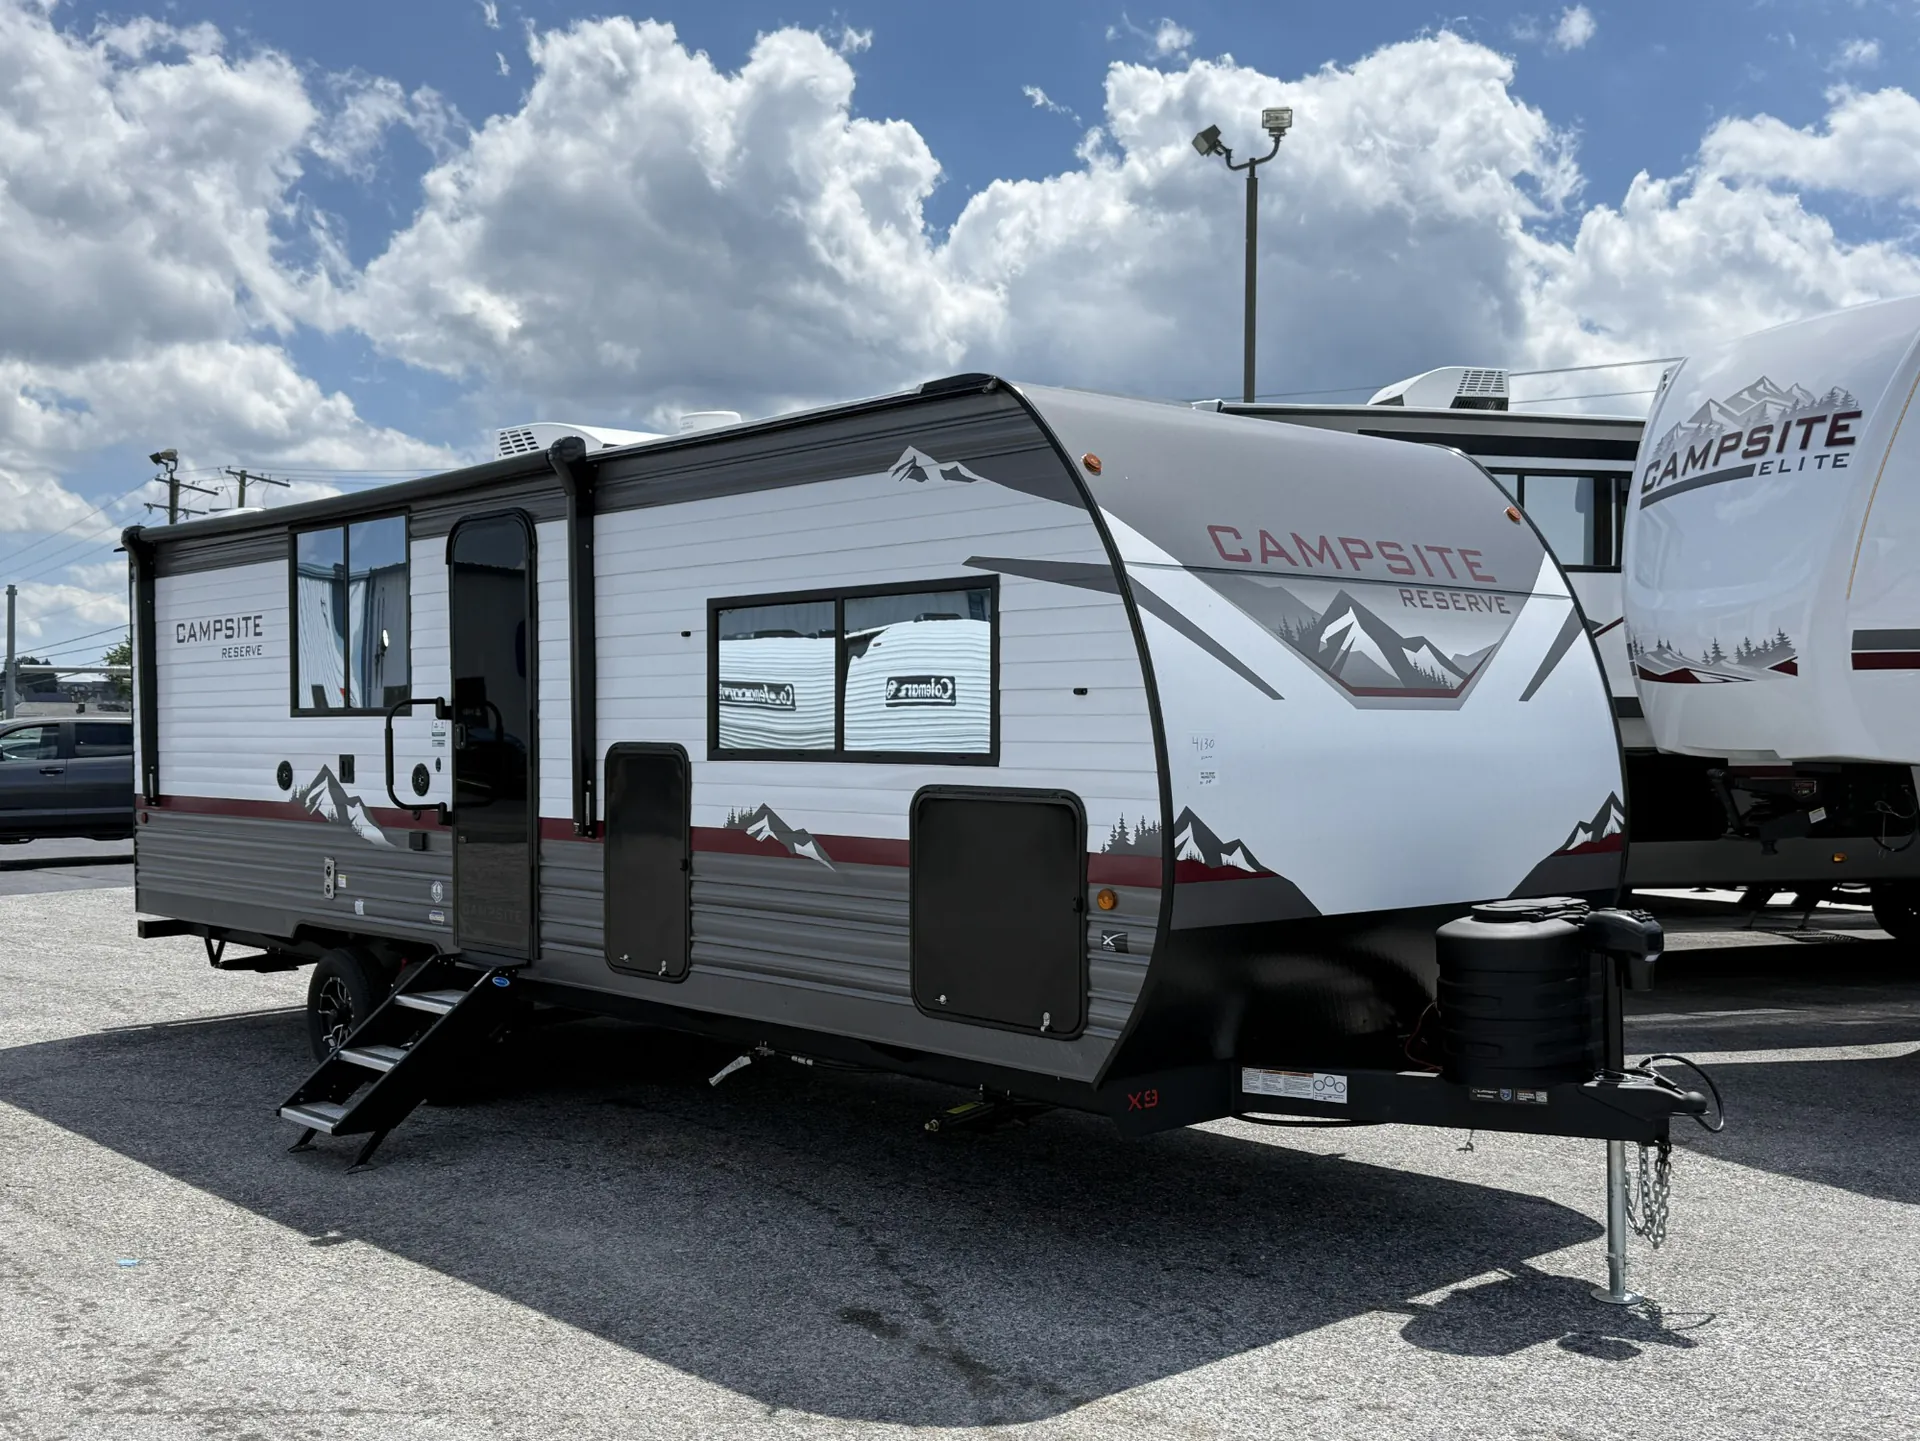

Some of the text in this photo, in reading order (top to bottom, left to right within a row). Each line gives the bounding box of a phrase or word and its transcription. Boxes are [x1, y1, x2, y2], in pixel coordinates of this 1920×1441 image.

[1641, 410, 1863, 494] CAMPSITE
[1758, 452, 1850, 476] ELITE
[1206, 524, 1498, 584] CAMPSITE
[1398, 588, 1512, 615] RESERVE
[176, 614, 263, 644] CAMPSITE
[221, 644, 263, 659] RESERVE
[1192, 735, 1215, 751] 4130
